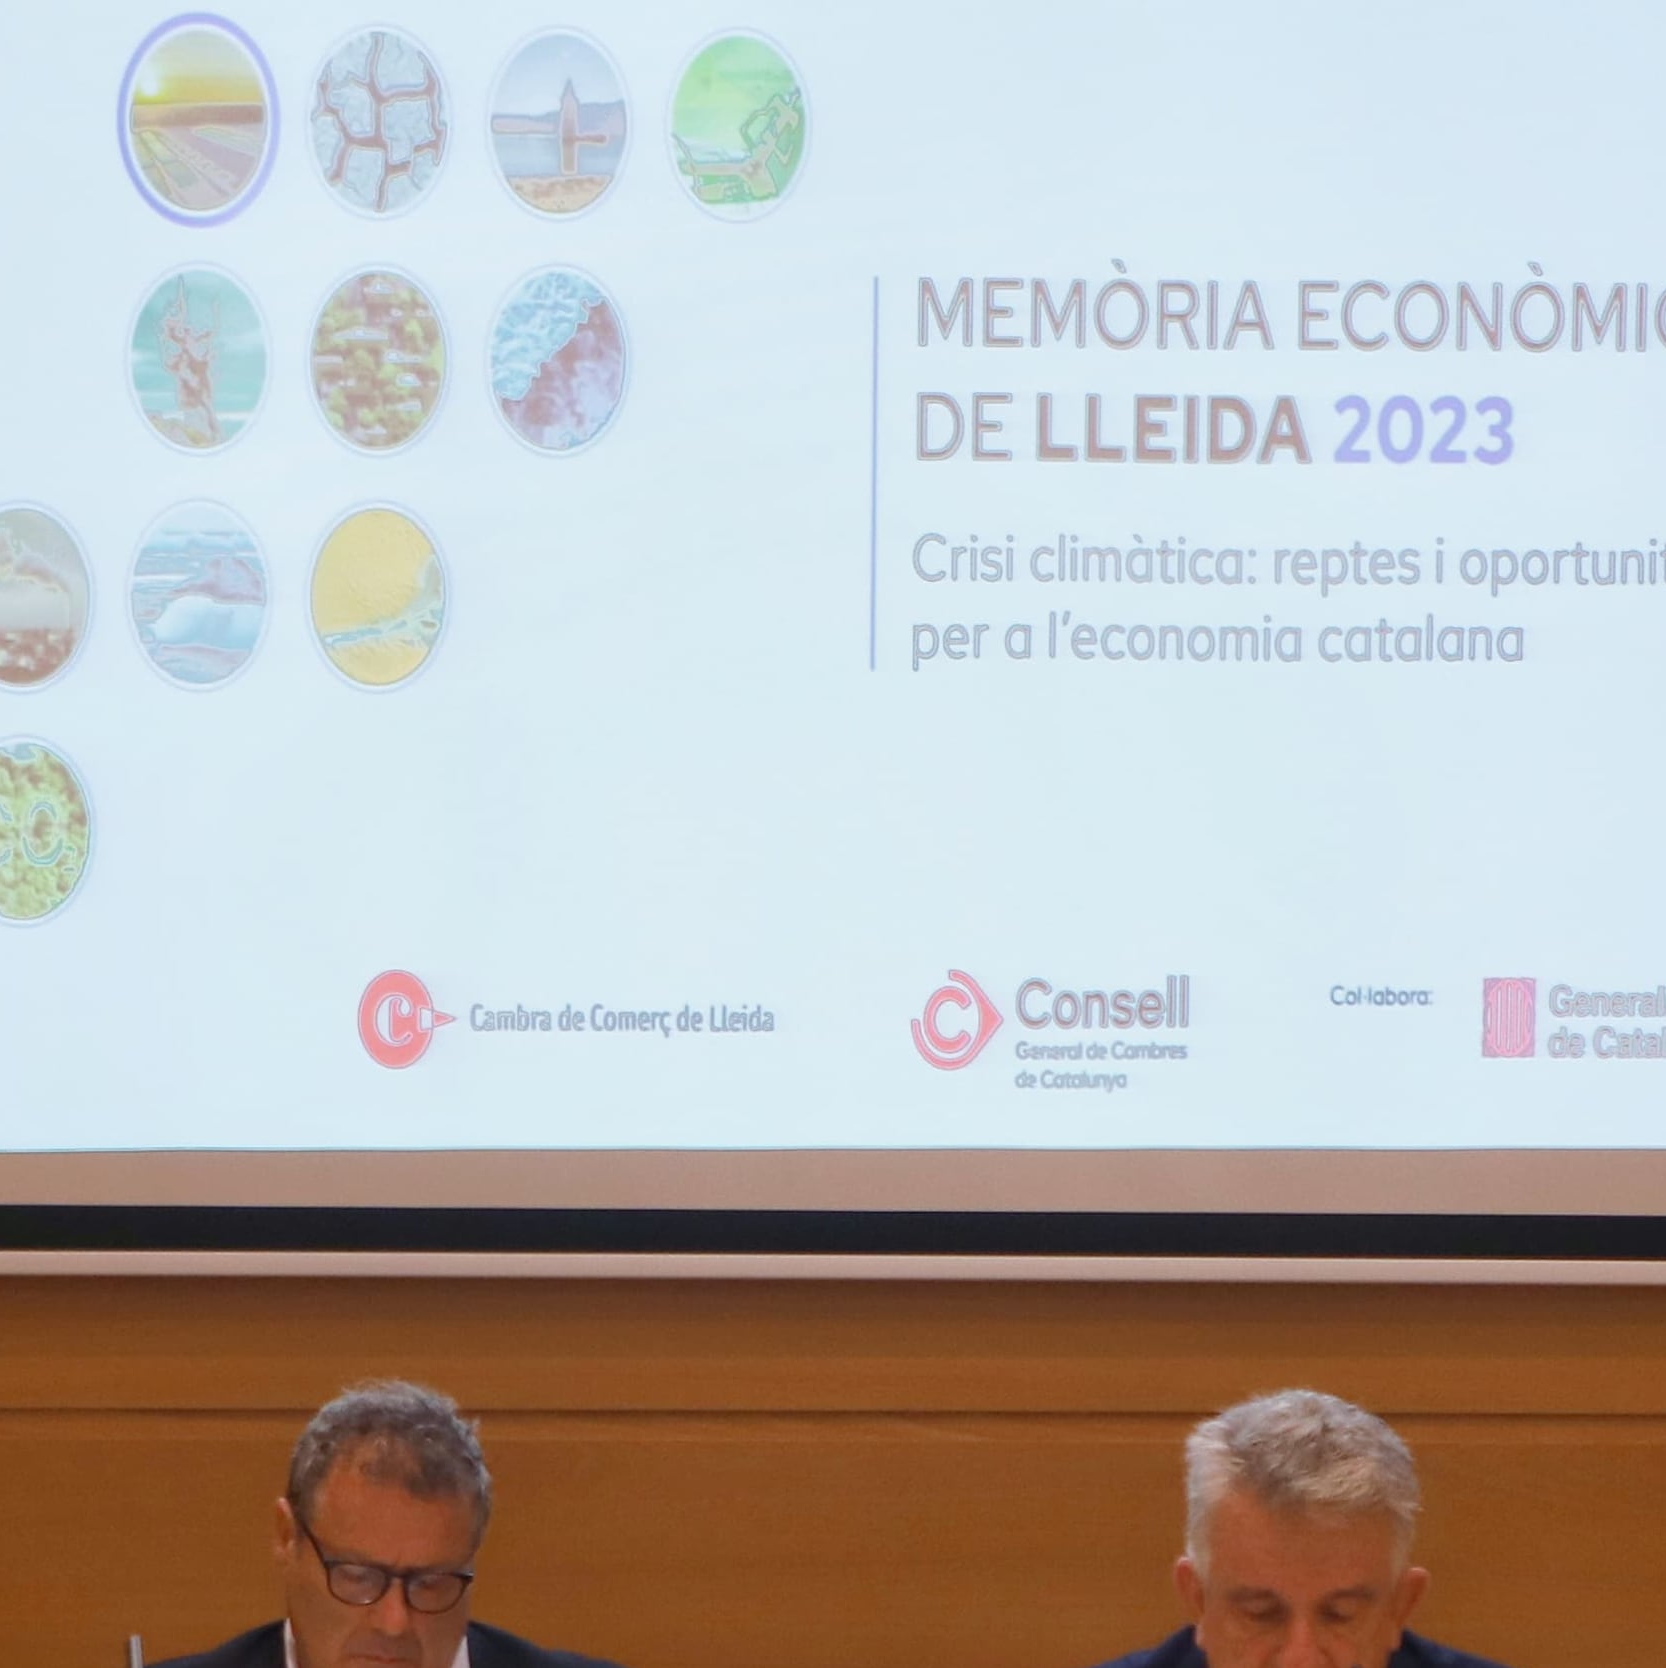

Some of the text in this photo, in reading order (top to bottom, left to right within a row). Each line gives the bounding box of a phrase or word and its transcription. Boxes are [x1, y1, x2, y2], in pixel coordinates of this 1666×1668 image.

[915, 259, 1275, 351] MEMÒRIA
[915, 391, 1516, 466] DE LLEIDA 2023
[912, 533, 1014, 583] Crisi
[1029, 533, 1257, 586] climàtica:
[1273, 541, 1421, 598] reptes
[1434, 537, 1445, 584] i
[911, 610, 1525, 672] per a l'economia catalana
[469, 1003, 776, 1039] Cambra de Comerç de Lleida
[1015, 974, 1191, 1030] Consell
[1015, 1040, 1188, 1061] General de Cambres
[1547, 1026, 1586, 1060] de
[1014, 1069, 1128, 1094] de Catalunya
